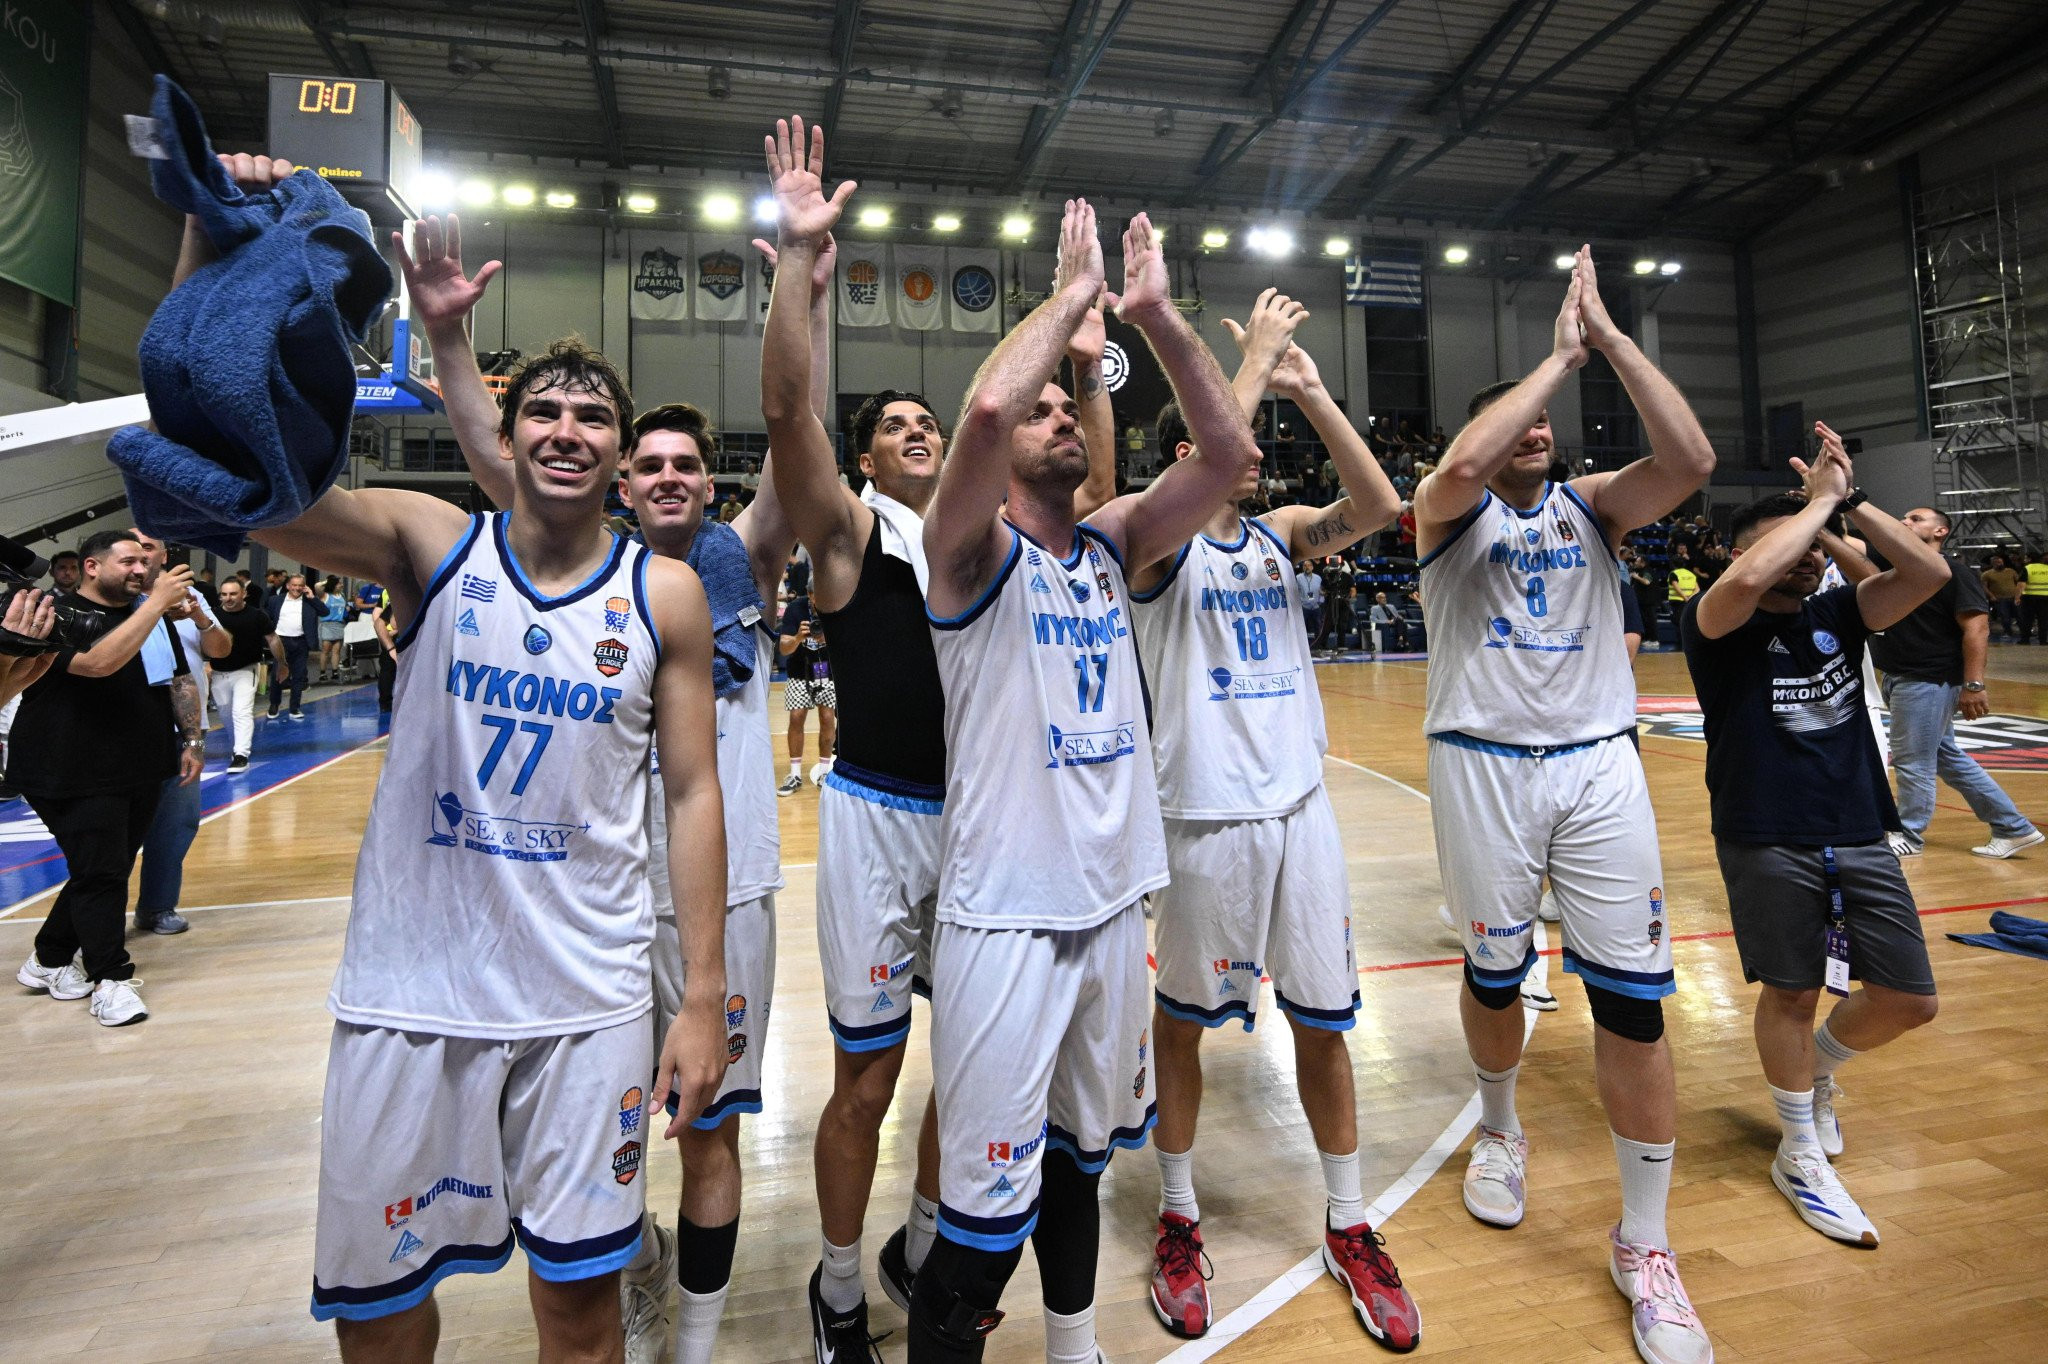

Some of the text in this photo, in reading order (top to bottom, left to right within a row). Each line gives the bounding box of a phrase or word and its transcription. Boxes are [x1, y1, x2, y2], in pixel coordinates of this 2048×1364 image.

[299, 80, 356, 114] 0:0
[318, 166, 362, 178] Quince
[637, 277, 681, 289] ΗΡΑΚΛΗΣ
[1514, 629, 1541, 644] SEA
[1545, 636, 1554, 644] &
[597, 646, 626, 660] ELITE
[598, 658, 622, 669] LEAGUE
[1074, 653, 1108, 714] 17
[1258, 681, 1266, 690] &
[1271, 674, 1293, 689] SKY
[477, 714, 553, 796] 77
[1065, 738, 1097, 756] SEA
[1101, 741, 1111, 753] &
[502, 830, 516, 846] &
[525, 828, 573, 849] SKY
[506, 850, 564, 861] AGENCY
[614, 1148, 641, 1167] ELITE
[416, 1177, 493, 1211] ΑΓΓΕΛΕΤΑΚΗΣ
